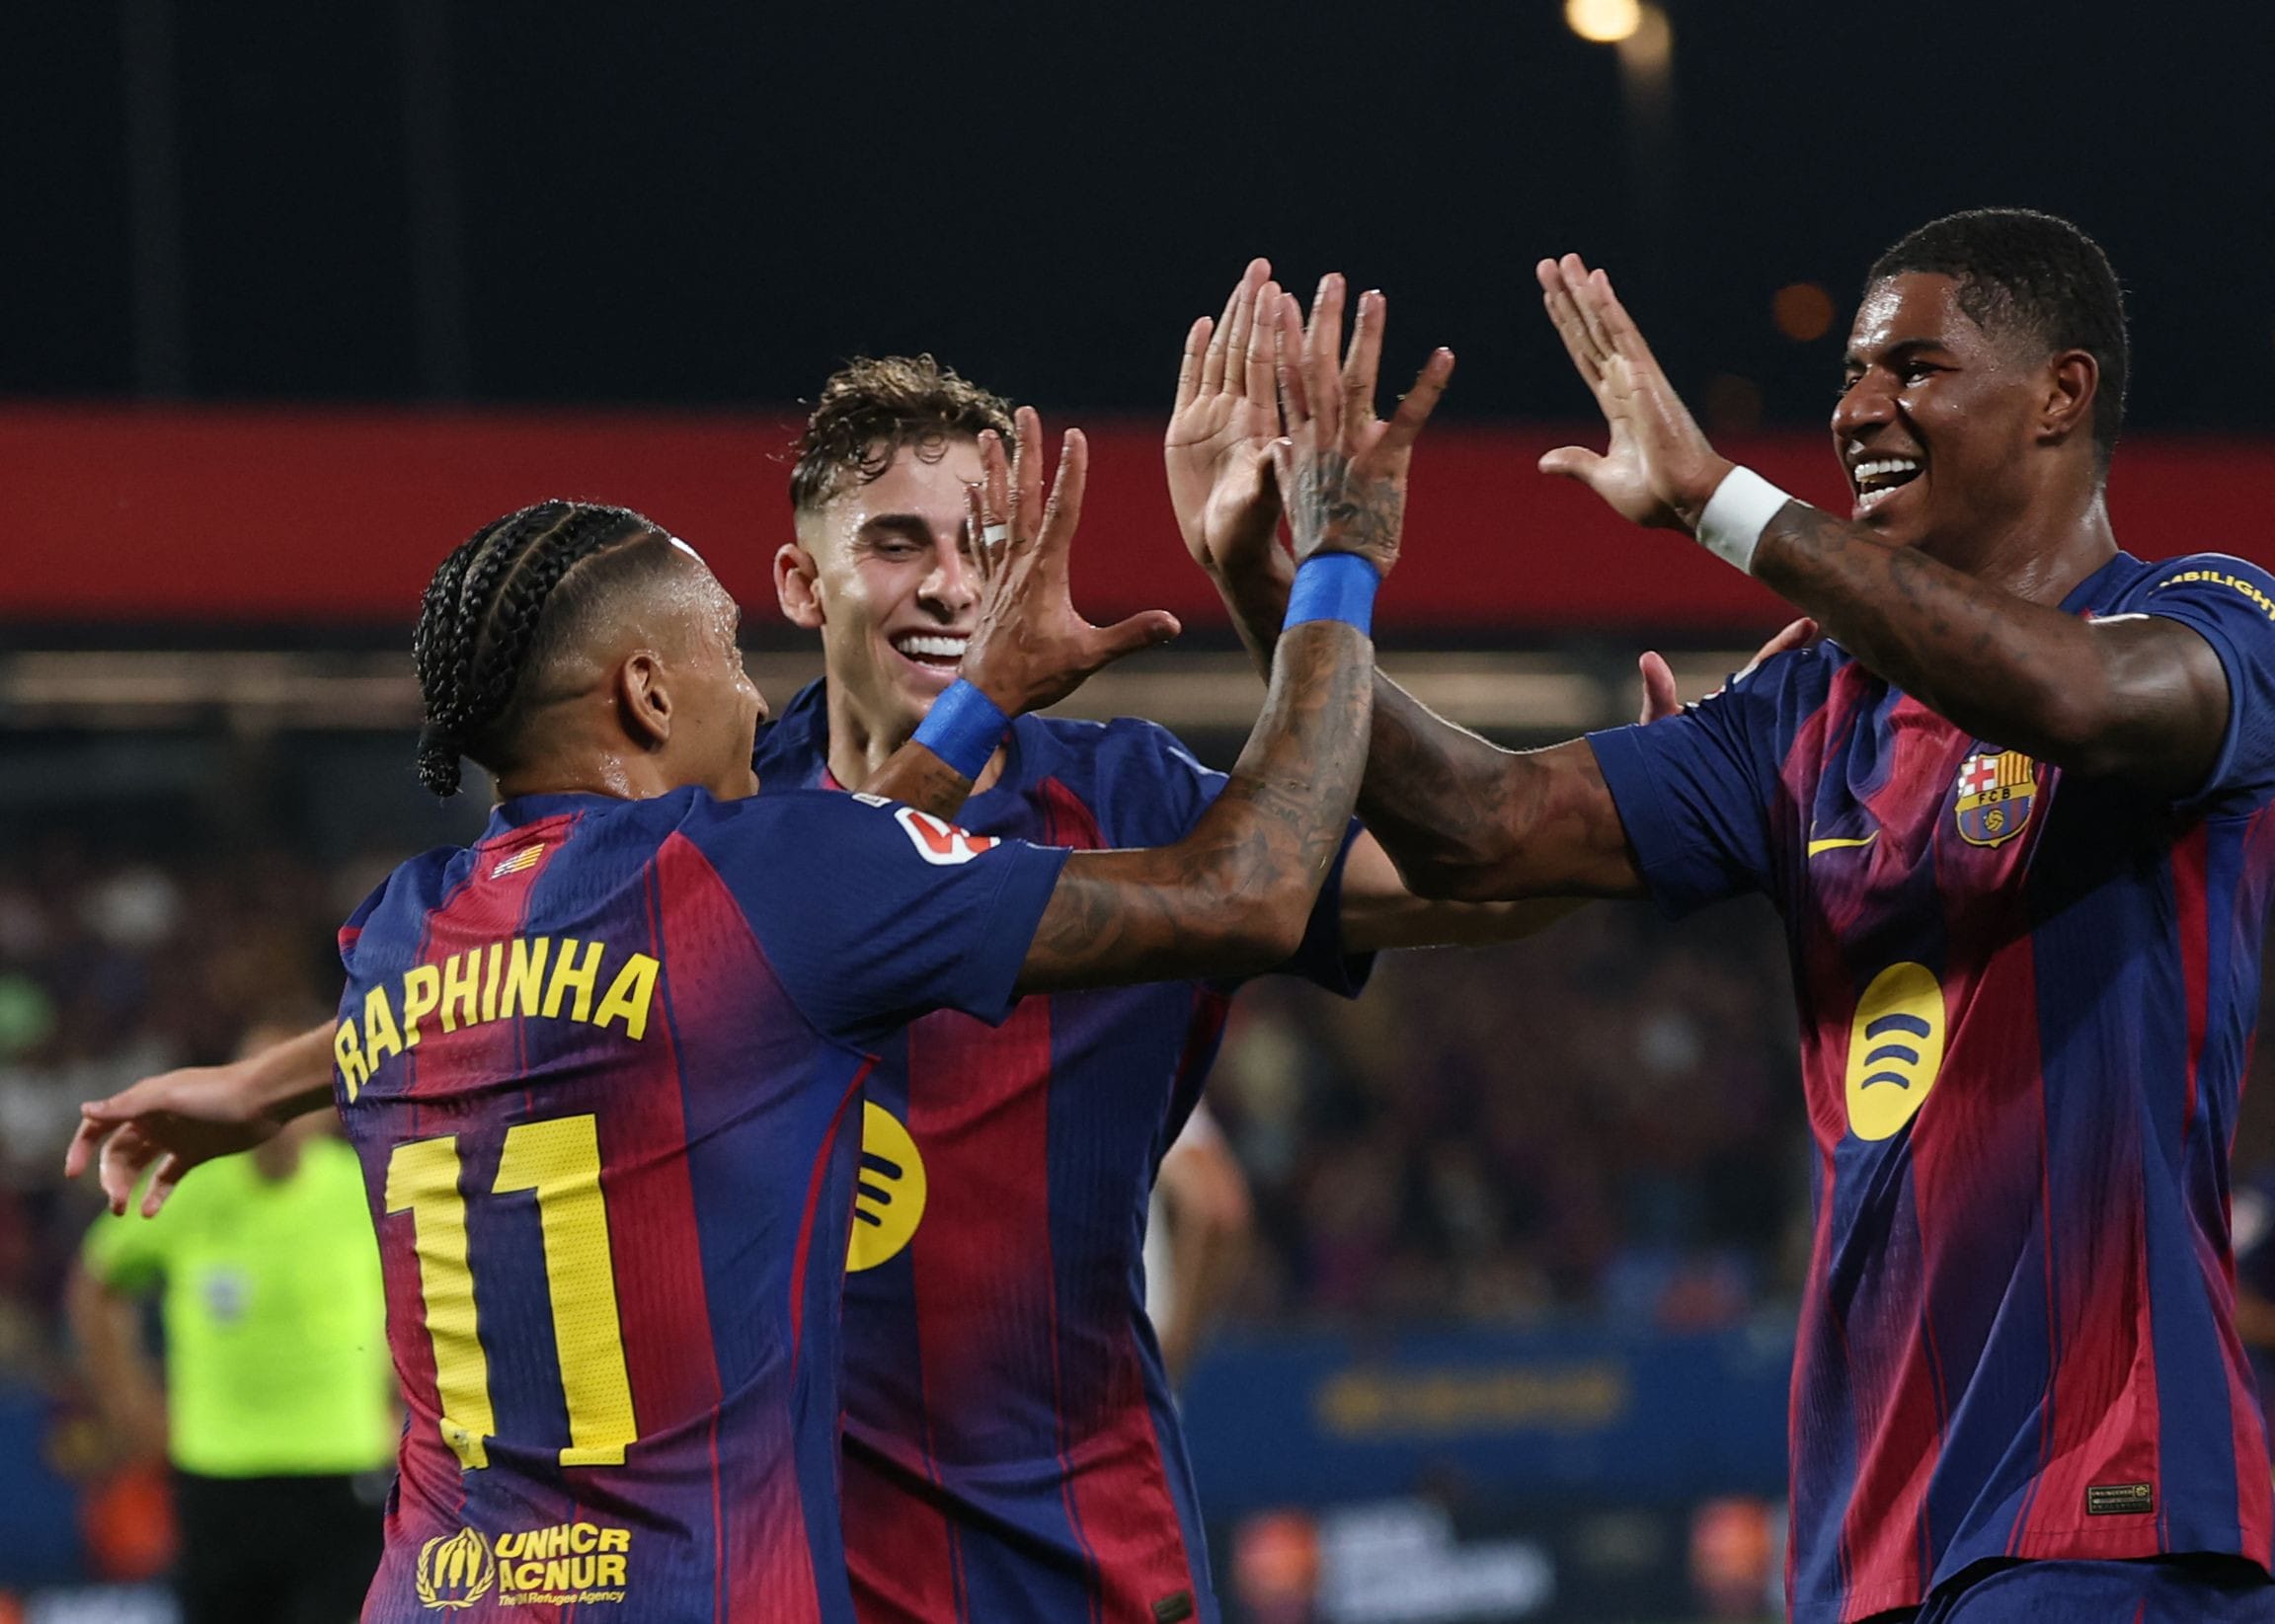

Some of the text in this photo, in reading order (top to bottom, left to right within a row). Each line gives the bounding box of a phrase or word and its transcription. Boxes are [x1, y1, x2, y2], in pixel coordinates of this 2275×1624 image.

[334, 937, 661, 1105] RAPHINHA
[385, 1113, 637, 1471] 11
[495, 1522, 631, 1561] UNHCR
[499, 1554, 627, 1592] ACNUR
[498, 1594, 514, 1606] The
[527, 1590, 578, 1606] Refugee
[578, 1590, 625, 1603] Agency
